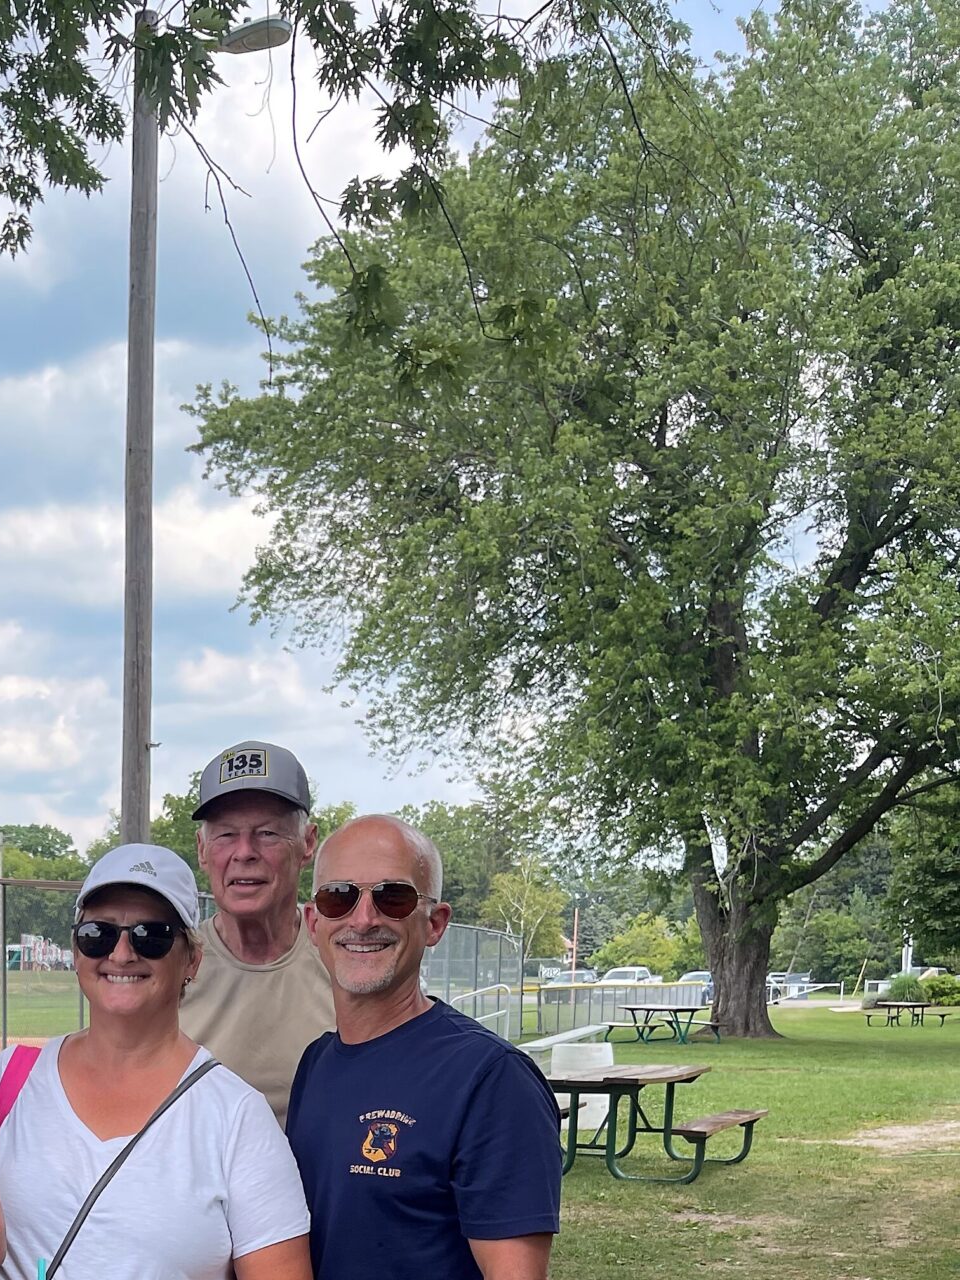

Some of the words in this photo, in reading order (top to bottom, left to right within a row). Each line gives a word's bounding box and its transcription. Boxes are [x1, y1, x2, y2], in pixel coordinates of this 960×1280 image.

[227, 754, 262, 772] 135
[228, 768, 261, 778] YEARS
[349, 1165, 376, 1175] SOCIAL
[377, 1167, 401, 1178] CLUB
